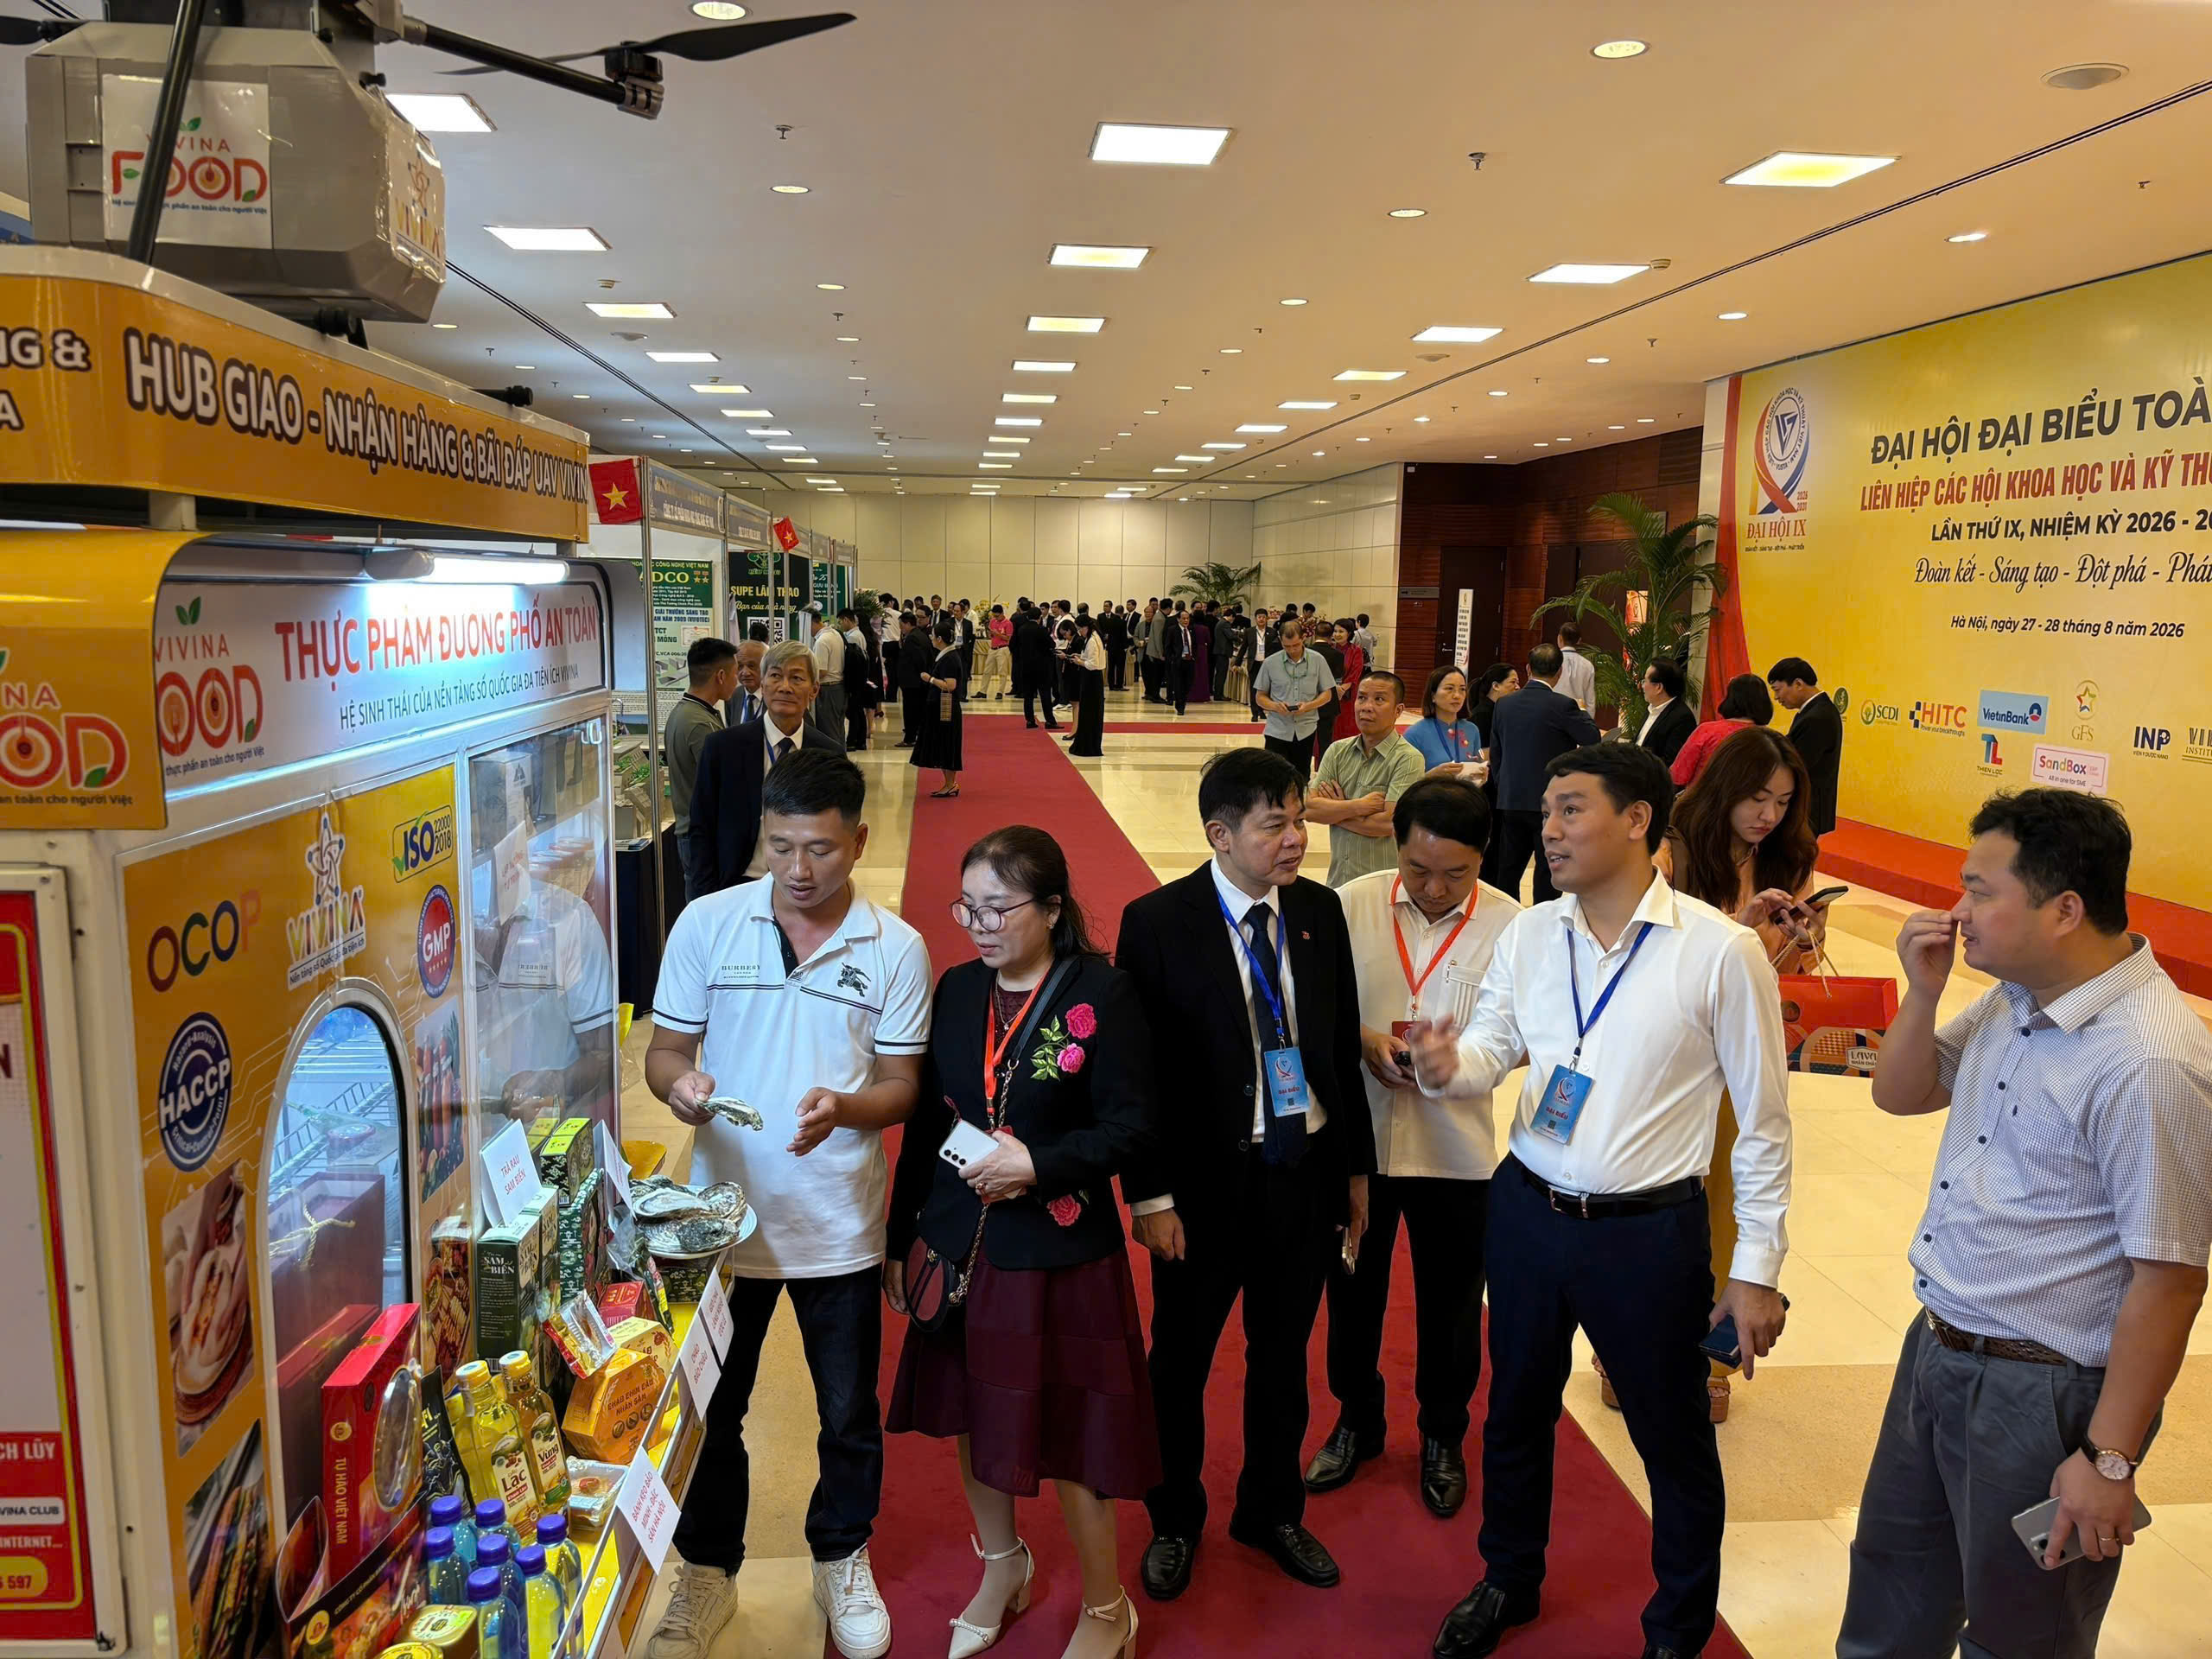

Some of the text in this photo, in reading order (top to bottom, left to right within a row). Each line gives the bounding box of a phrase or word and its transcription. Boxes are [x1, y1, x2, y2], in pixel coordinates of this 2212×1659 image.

[146, 133, 231, 153] VINA
[54, 329, 91, 370] &
[124, 331, 219, 423] HUB
[223, 363, 302, 443] GIAO
[323, 388, 397, 474] NHẬN
[401, 404, 459, 478] HÀNG
[461, 429, 476, 480] &
[476, 429, 502, 486] BÃI
[503, 435, 531, 492] ĐÁP
[533, 451, 558, 498] UAV
[1871, 429, 1916, 470] ĐẠI
[1921, 415, 1971, 464] HỘI
[1978, 411, 2033, 457] ĐẠI
[2041, 387, 2122, 443] BIỂU
[1860, 448, 2212, 513] LIÊN HIỆP CÁC HỘI KHOA HỌC VÀ KỸ TH
[1746, 516, 1807, 543] ĐẠI HỘI IX
[1931, 508, 2176, 542] LẦN THỨ IX, NHIỆM KỲ 2026
[1914, 553, 2147, 594] Đoàn kết Sáng tạo Đột phá
[730, 586, 754, 596] SUPE
[1950, 615, 2185, 638] Hà Nội, ngày 27 28 tháng 8 năm 2026
[274, 610, 360, 691] THỰC
[510, 594, 542, 653] PHỐ
[545, 607, 563, 648] AN
[565, 596, 597, 644] TOÀN
[340, 701, 356, 734] HỆ
[359, 699, 385, 726] SINH
[387, 691, 410, 720] THÁI
[511, 673, 524, 692] GIA
[524, 671, 534, 690] ĐA
[534, 665, 549, 692] TIỆN
[550, 662, 560, 683] ÍCH
[1876, 704, 1899, 721] SCDI
[1921, 702, 1967, 728] HITC
[1982, 707, 2030, 726] VietinBank
[2071, 724, 2094, 741] GFS
[2133, 726, 2171, 751] INP
[2039, 754, 2088, 775] SandBox
[403, 814, 450, 871] ISO 22000
[435, 830, 452, 855] 2018
[148, 890, 262, 992] OCOP
[423, 921, 451, 963] GMP
[159, 1057, 232, 1130] HACCP
[484, 1255, 505, 1266] SAM
[24, 1439, 56, 1460] LŨY
[501, 1468, 527, 1493] Lạc
[29, 1505, 60, 1516] CLUB
[336, 1519, 347, 1545] NAM
[8, 1575, 32, 1590] 597
